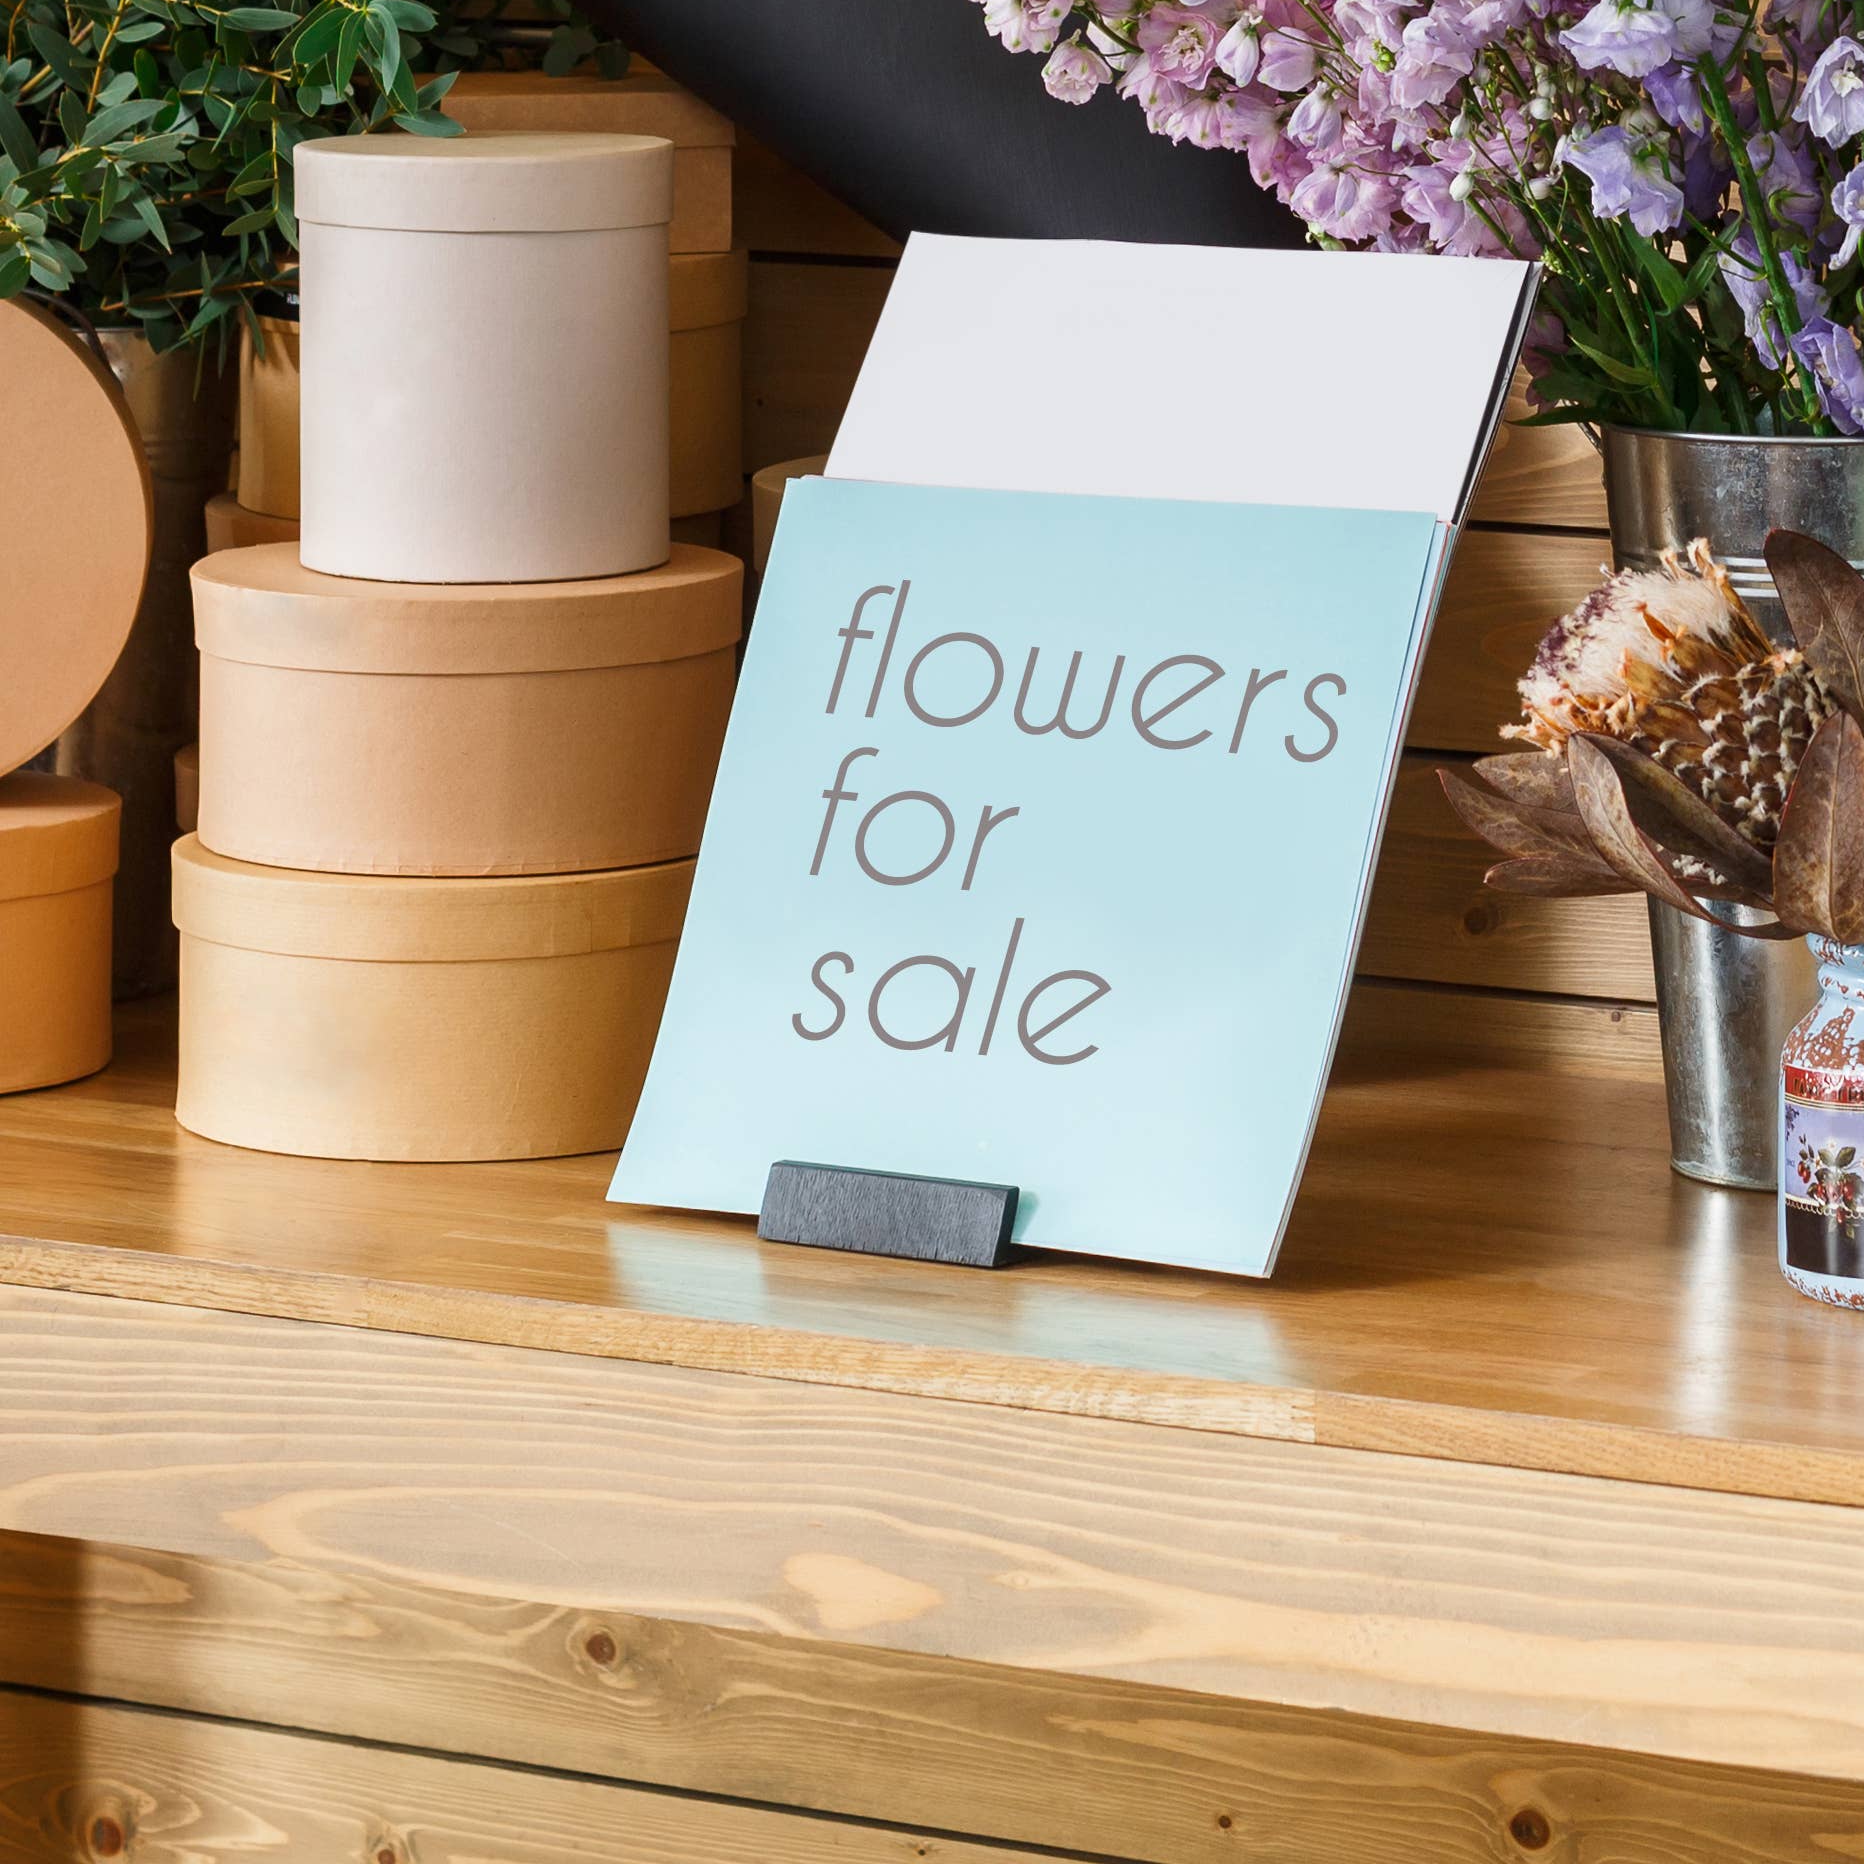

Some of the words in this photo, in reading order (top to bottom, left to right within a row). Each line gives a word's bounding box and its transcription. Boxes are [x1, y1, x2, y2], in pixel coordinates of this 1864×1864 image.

[825, 579, 1348, 763] flowers
[809, 746, 1021, 892] for
[791, 917, 1112, 1067] sale
